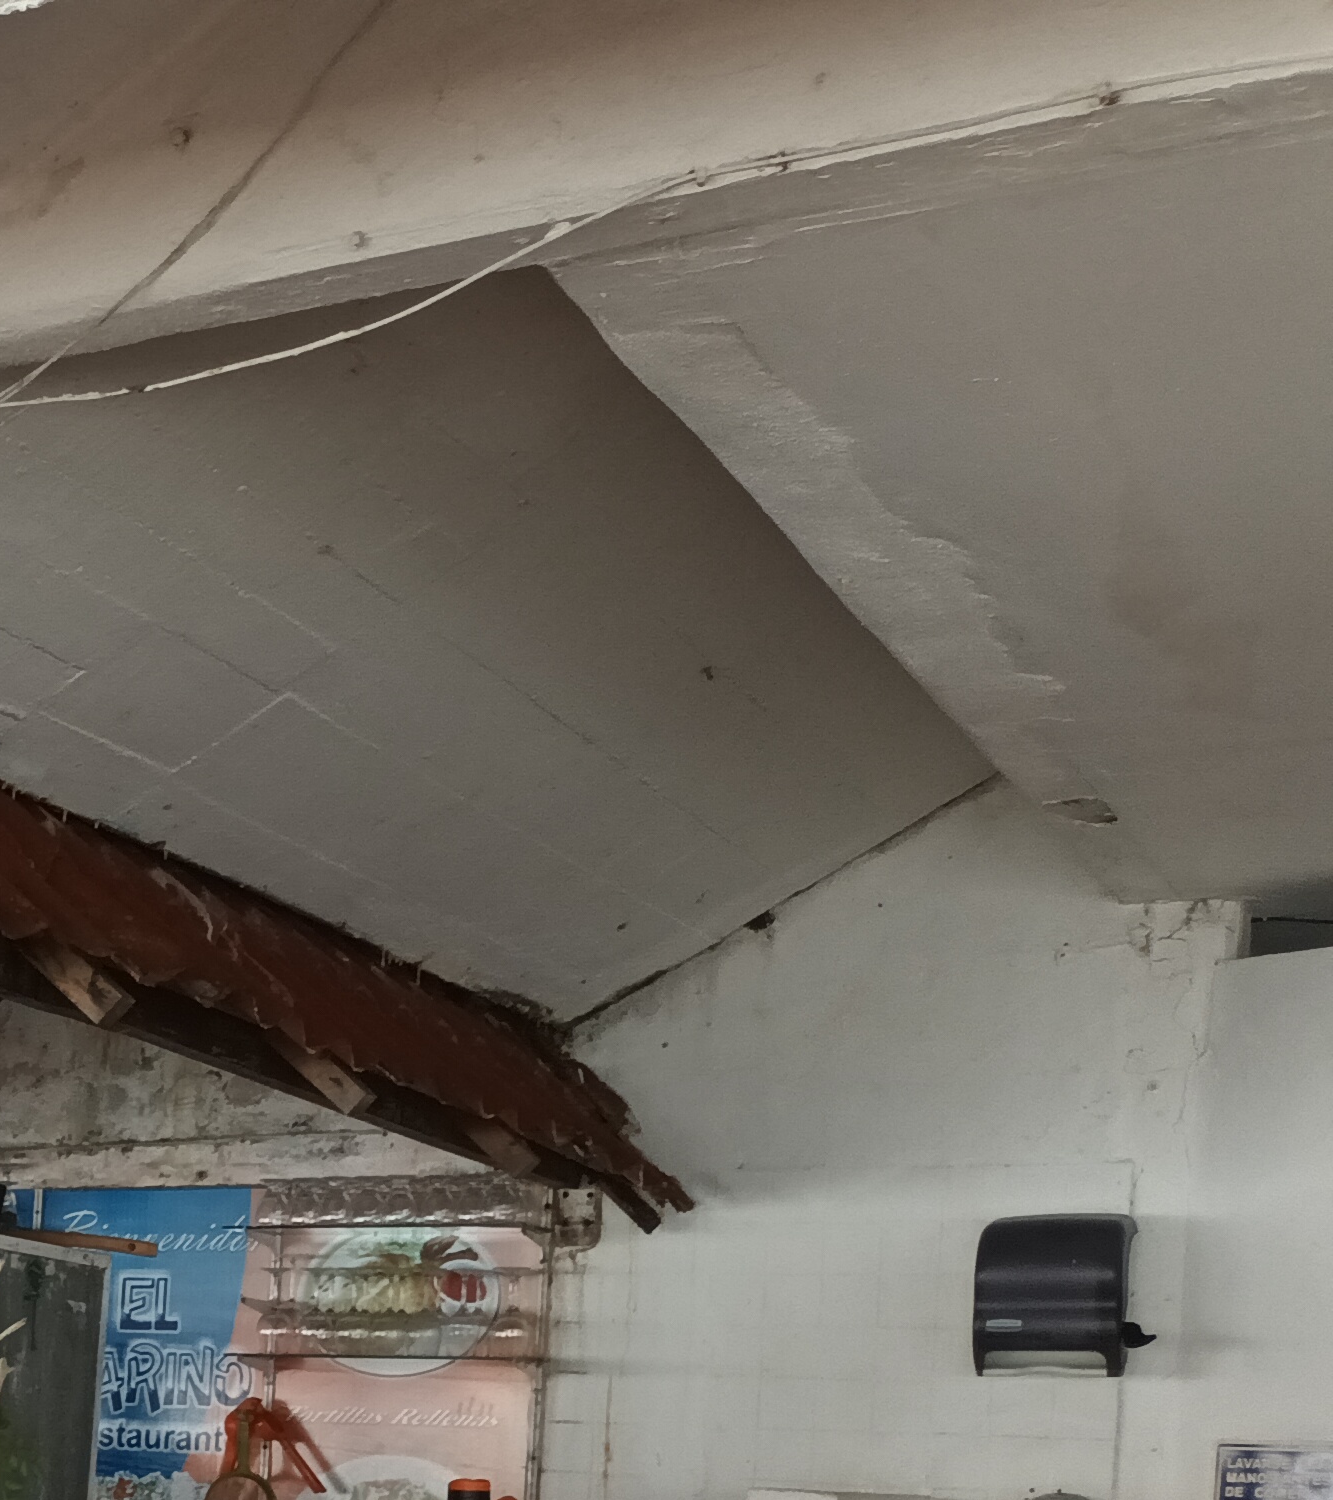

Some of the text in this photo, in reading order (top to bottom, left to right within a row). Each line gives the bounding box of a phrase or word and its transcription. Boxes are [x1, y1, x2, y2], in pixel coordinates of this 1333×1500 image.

[119, 1277, 179, 1331] EL
[101, 1342, 253, 1414] ARINO
[1224, 1486, 1245, 1498] DE
